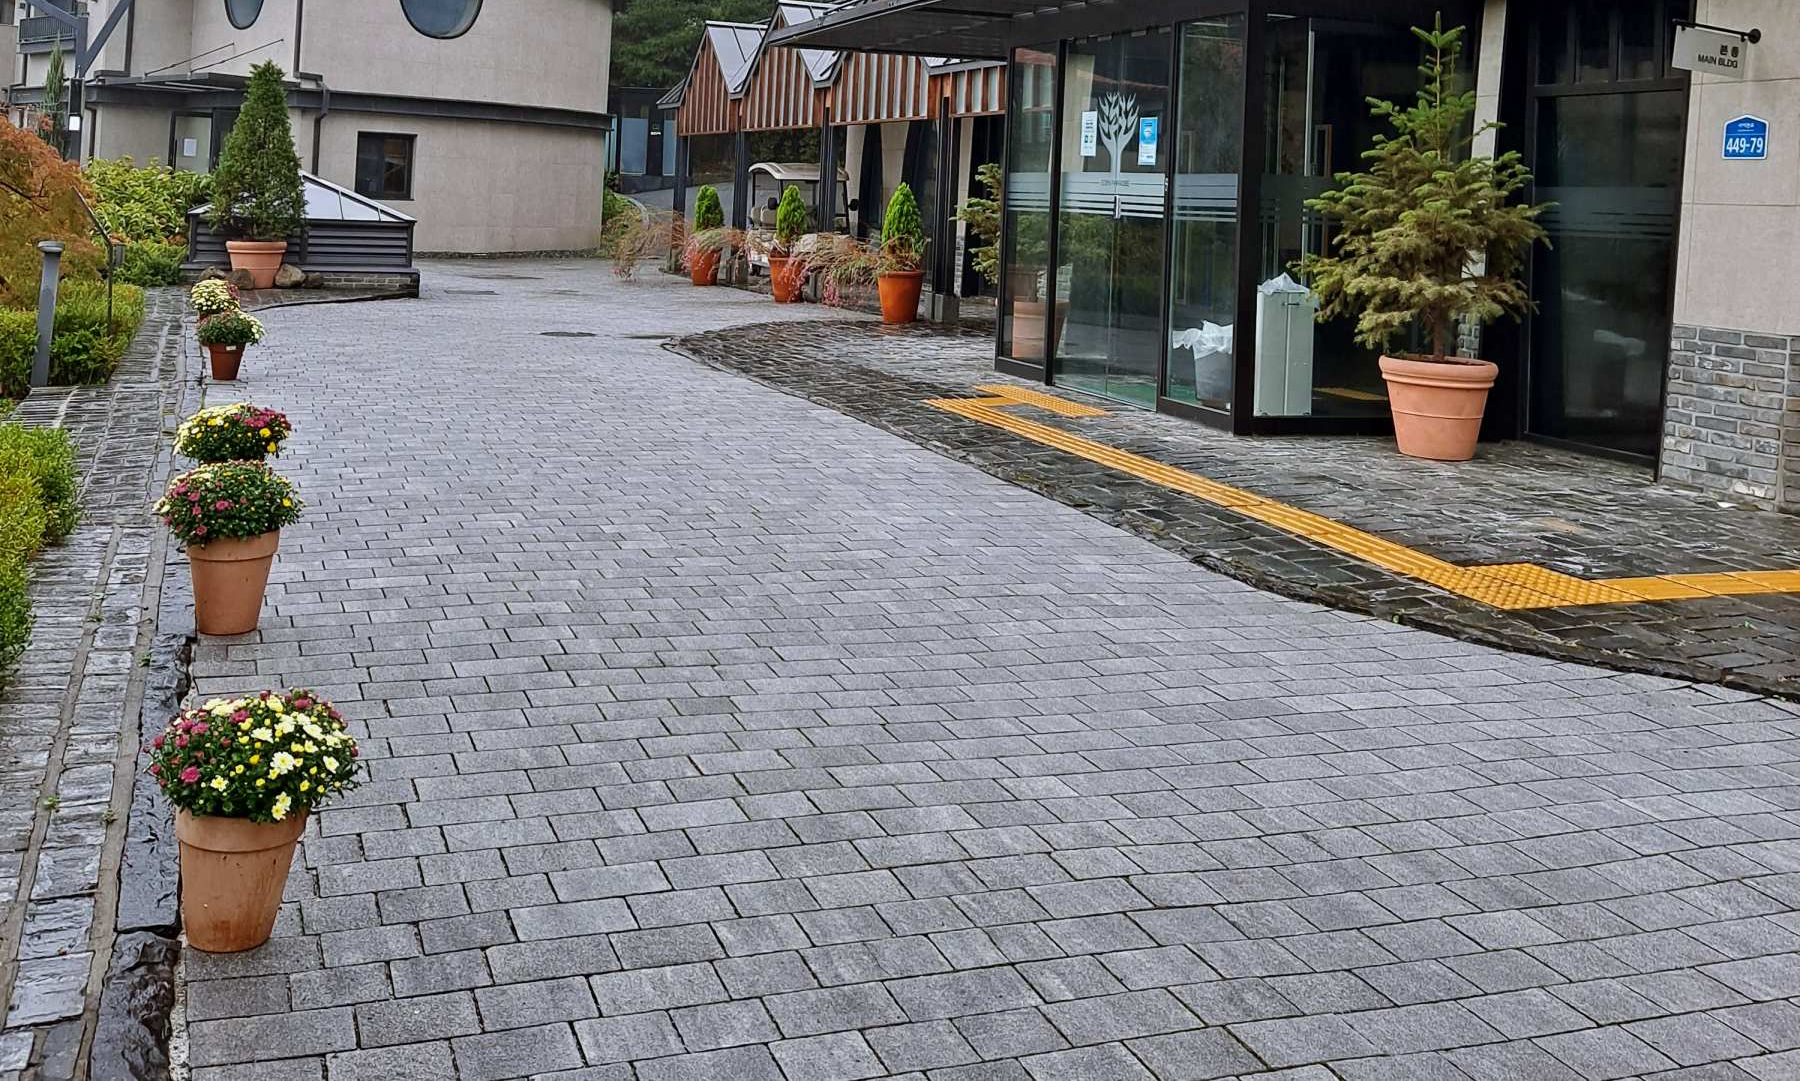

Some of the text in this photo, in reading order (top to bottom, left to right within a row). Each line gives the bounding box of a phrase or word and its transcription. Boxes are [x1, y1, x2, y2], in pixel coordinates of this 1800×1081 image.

[1698, 54, 1738, 68] MAIN BLDG
[1726, 137, 1764, 153] 449-79
